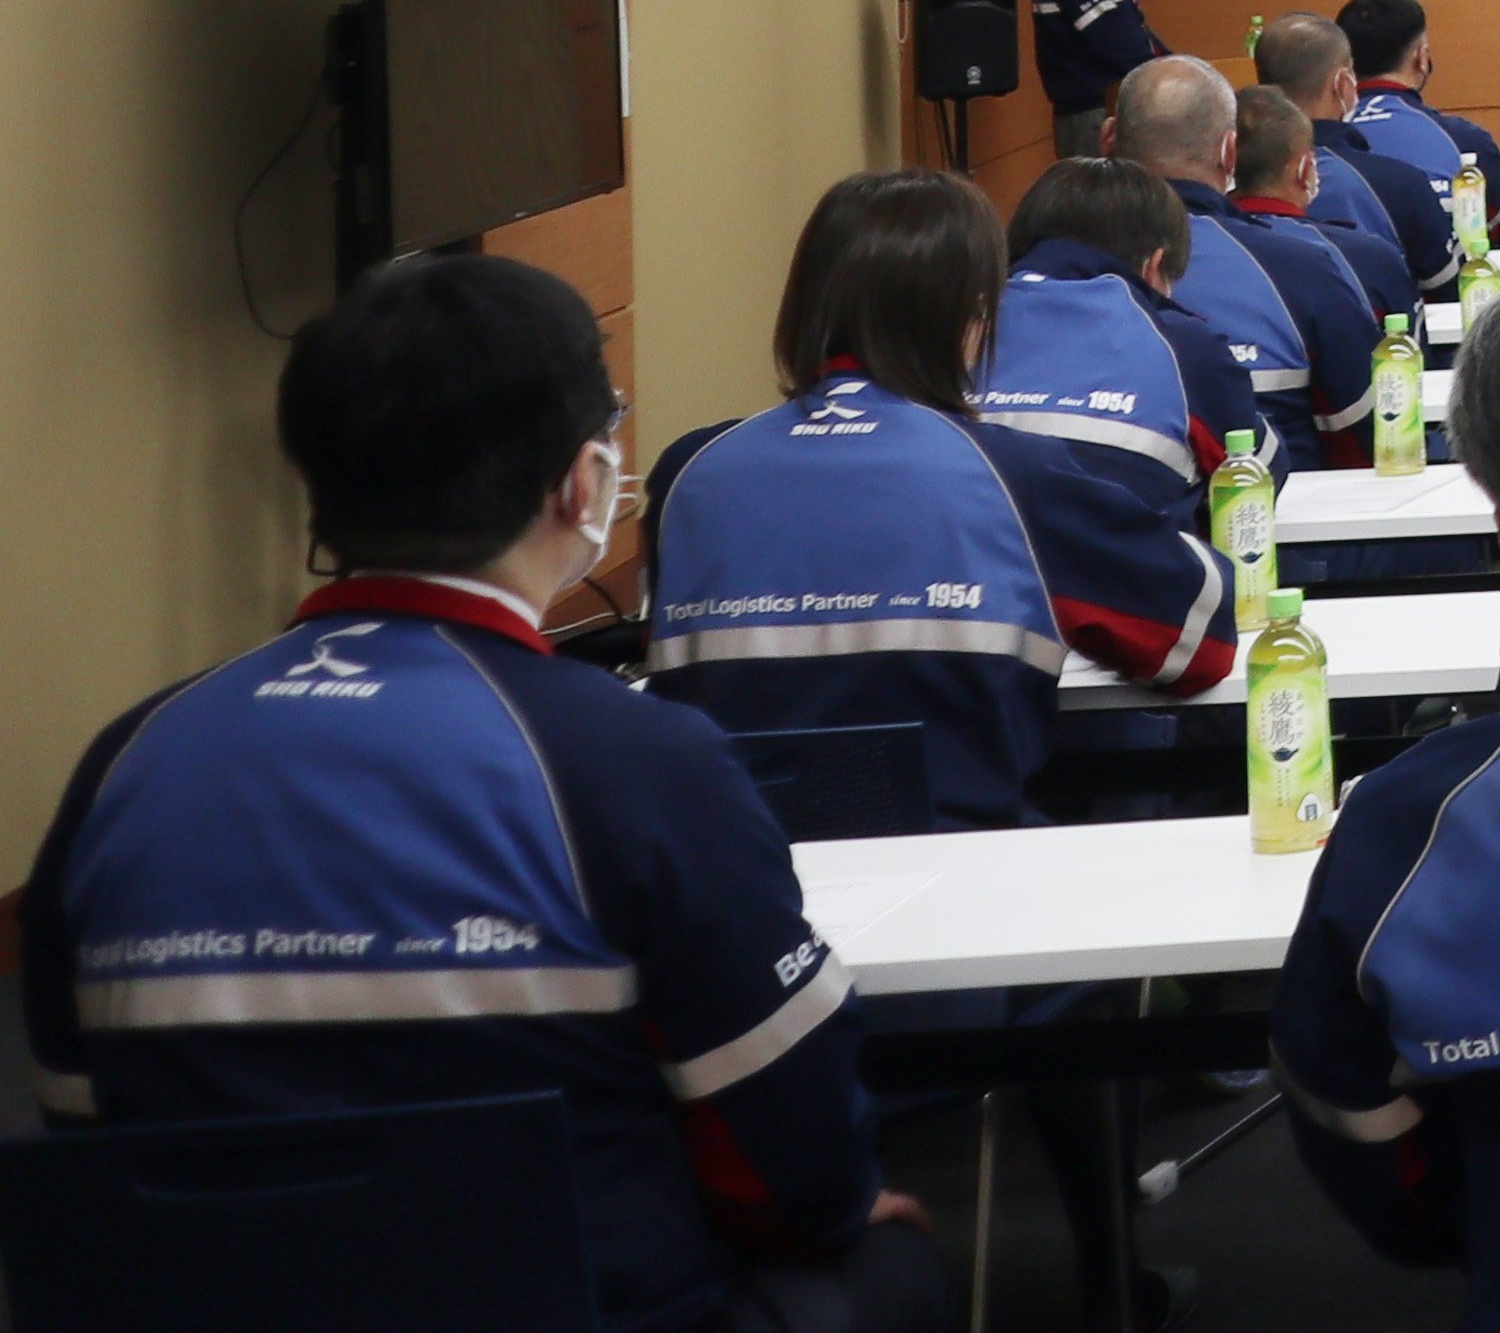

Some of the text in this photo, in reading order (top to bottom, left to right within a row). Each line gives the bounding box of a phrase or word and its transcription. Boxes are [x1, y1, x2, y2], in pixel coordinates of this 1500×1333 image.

[983, 388, 1049, 408] Partner
[1088, 389, 1136, 416] 1954
[790, 423, 877, 436] SHO RIKU
[664, 582, 984, 623] Total Logistics Partner since 1954
[254, 679, 384, 700] SHO RIKU
[1269, 689, 1295, 745] 綾鷹
[126, 928, 245, 964] Logistics
[253, 927, 374, 959] Partner
[1423, 1031, 1500, 1066] Total
